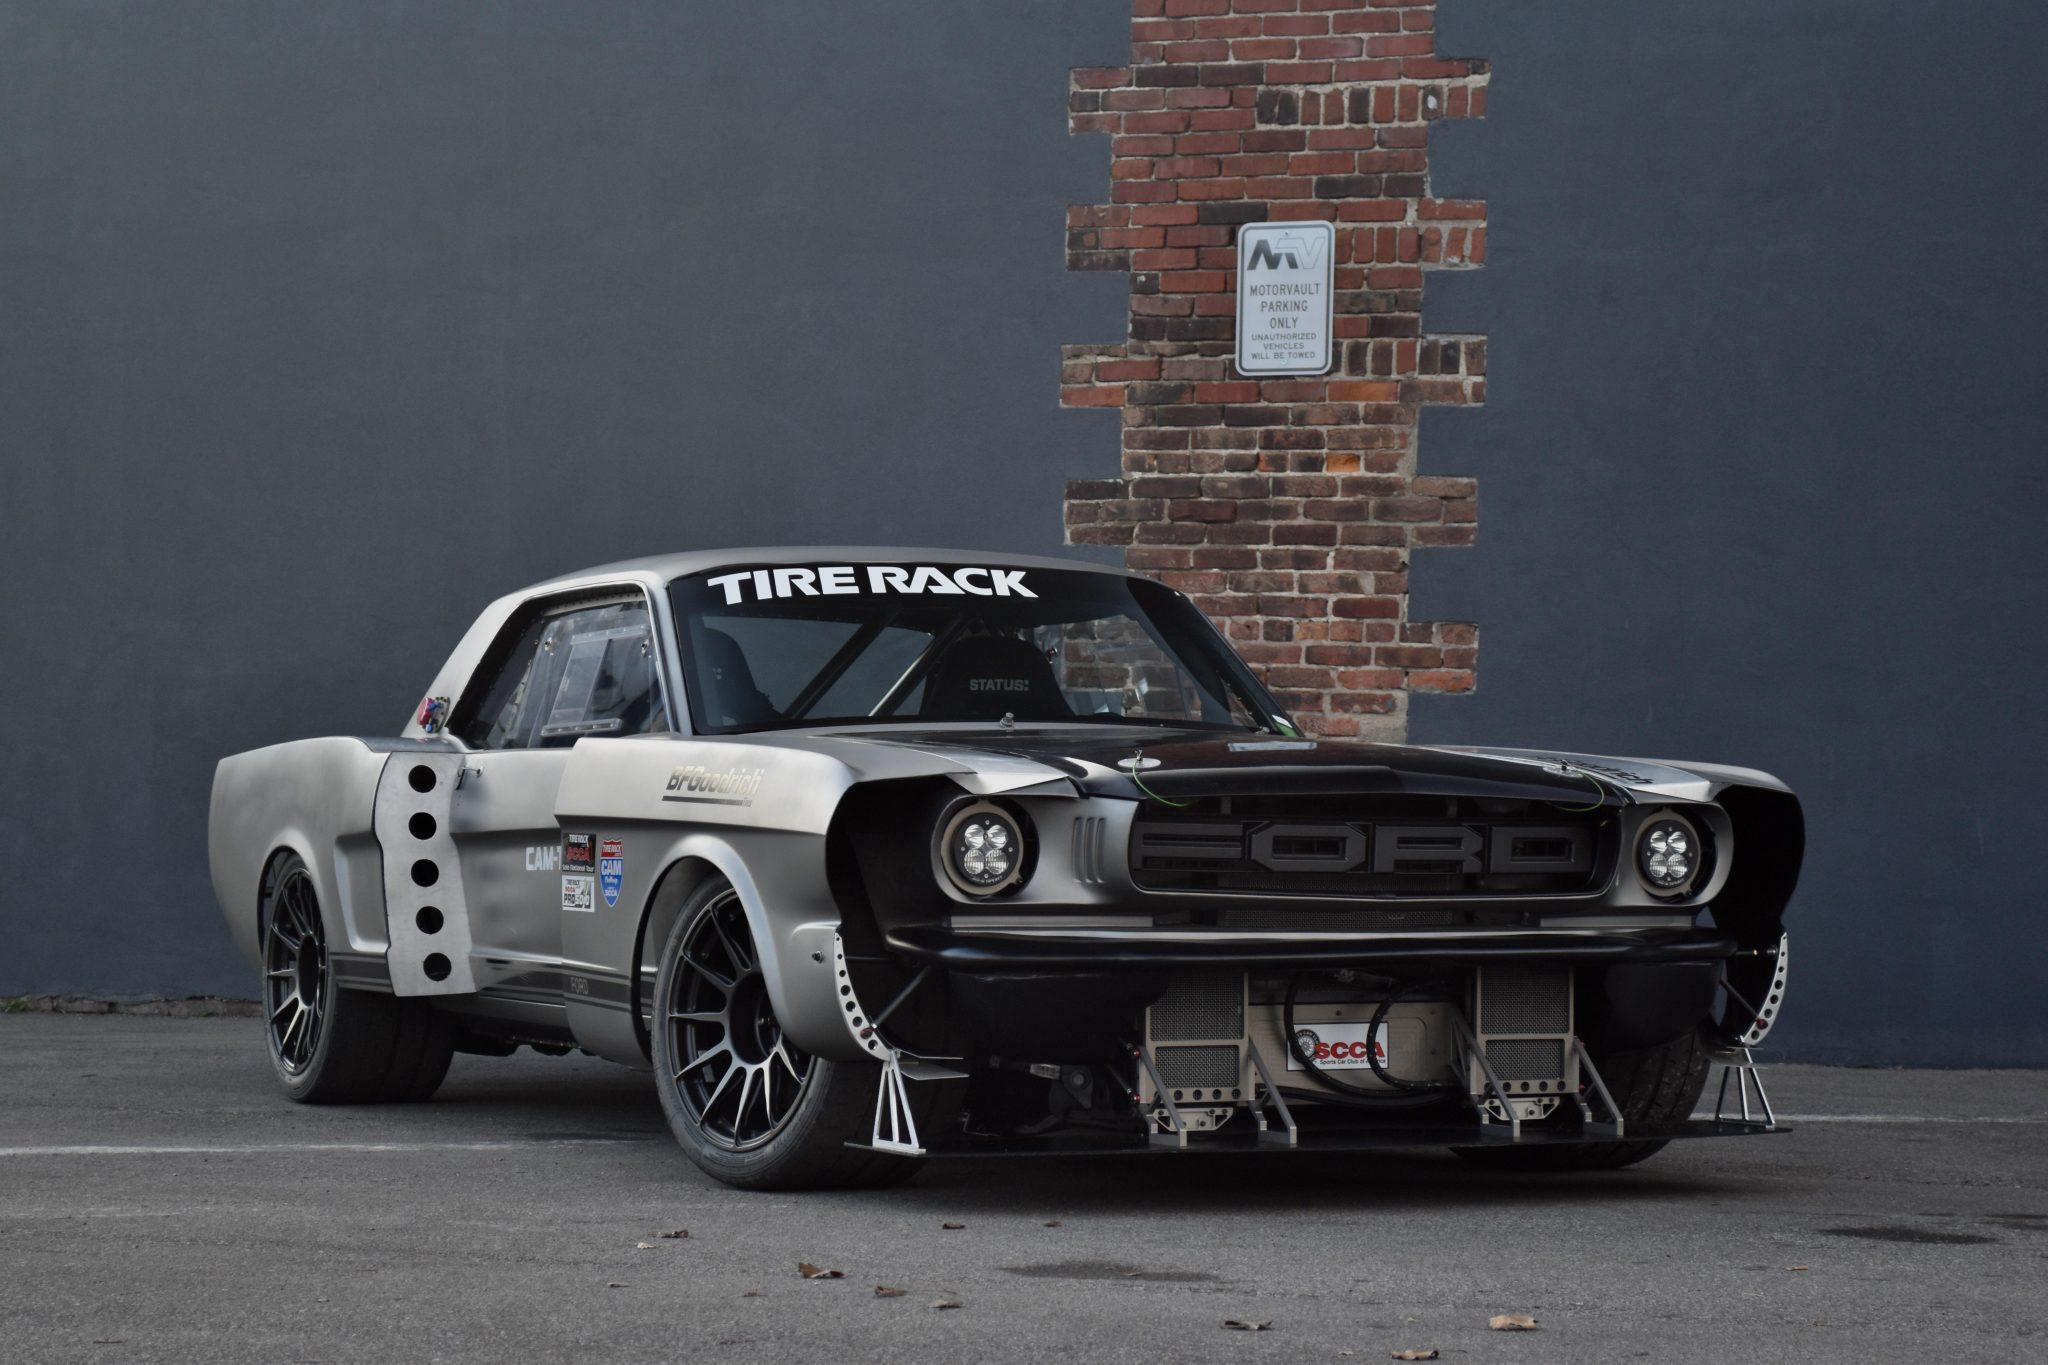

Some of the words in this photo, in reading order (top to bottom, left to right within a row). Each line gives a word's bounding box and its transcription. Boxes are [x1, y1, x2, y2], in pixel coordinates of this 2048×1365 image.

[1250, 283, 1321, 297] MOTORVAULT
[1260, 300, 1308, 313] PARKING
[1270, 317, 1299, 329] ONLY
[1251, 332, 1317, 341] UNAUTHORIZED
[1263, 342, 1304, 350] VEHICLES
[1251, 352, 1270, 360] WILL
[1273, 352, 1285, 360] BE
[1288, 351, 1316, 359] TOWED
[707, 565, 861, 606] TIRE
[867, 565, 1040, 599] RACK
[665, 764, 766, 796] BFGoodrich
[1133, 820, 1594, 875] FORD
[601, 859, 622, 876] CAM
